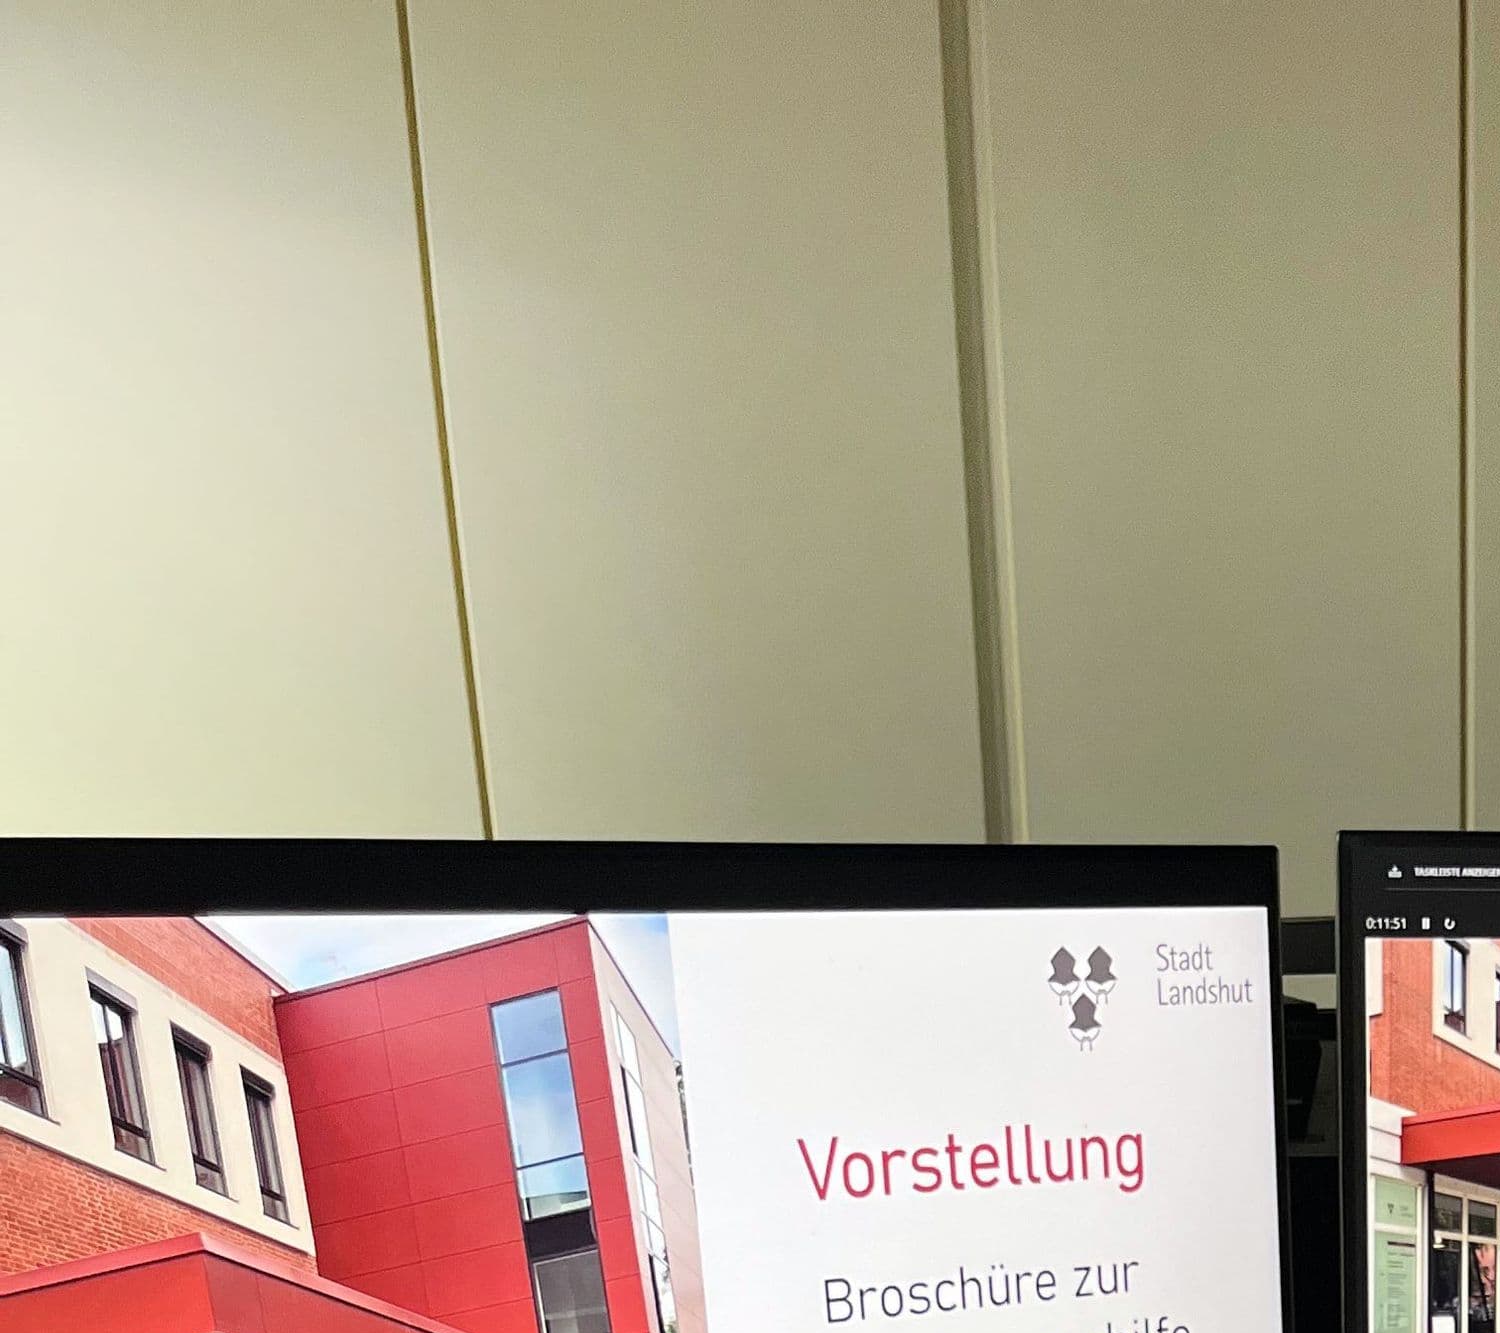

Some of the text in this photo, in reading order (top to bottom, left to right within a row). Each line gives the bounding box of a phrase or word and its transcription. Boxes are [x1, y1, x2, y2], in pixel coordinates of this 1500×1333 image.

[1366, 917, 1407, 931] 0:11:51
[1156, 943, 1214, 973] Stadt
[1157, 977, 1254, 1007] Landshut
[796, 1124, 1145, 1201] Vorstellung
[823, 1258, 1140, 1324] Broschüre zur
